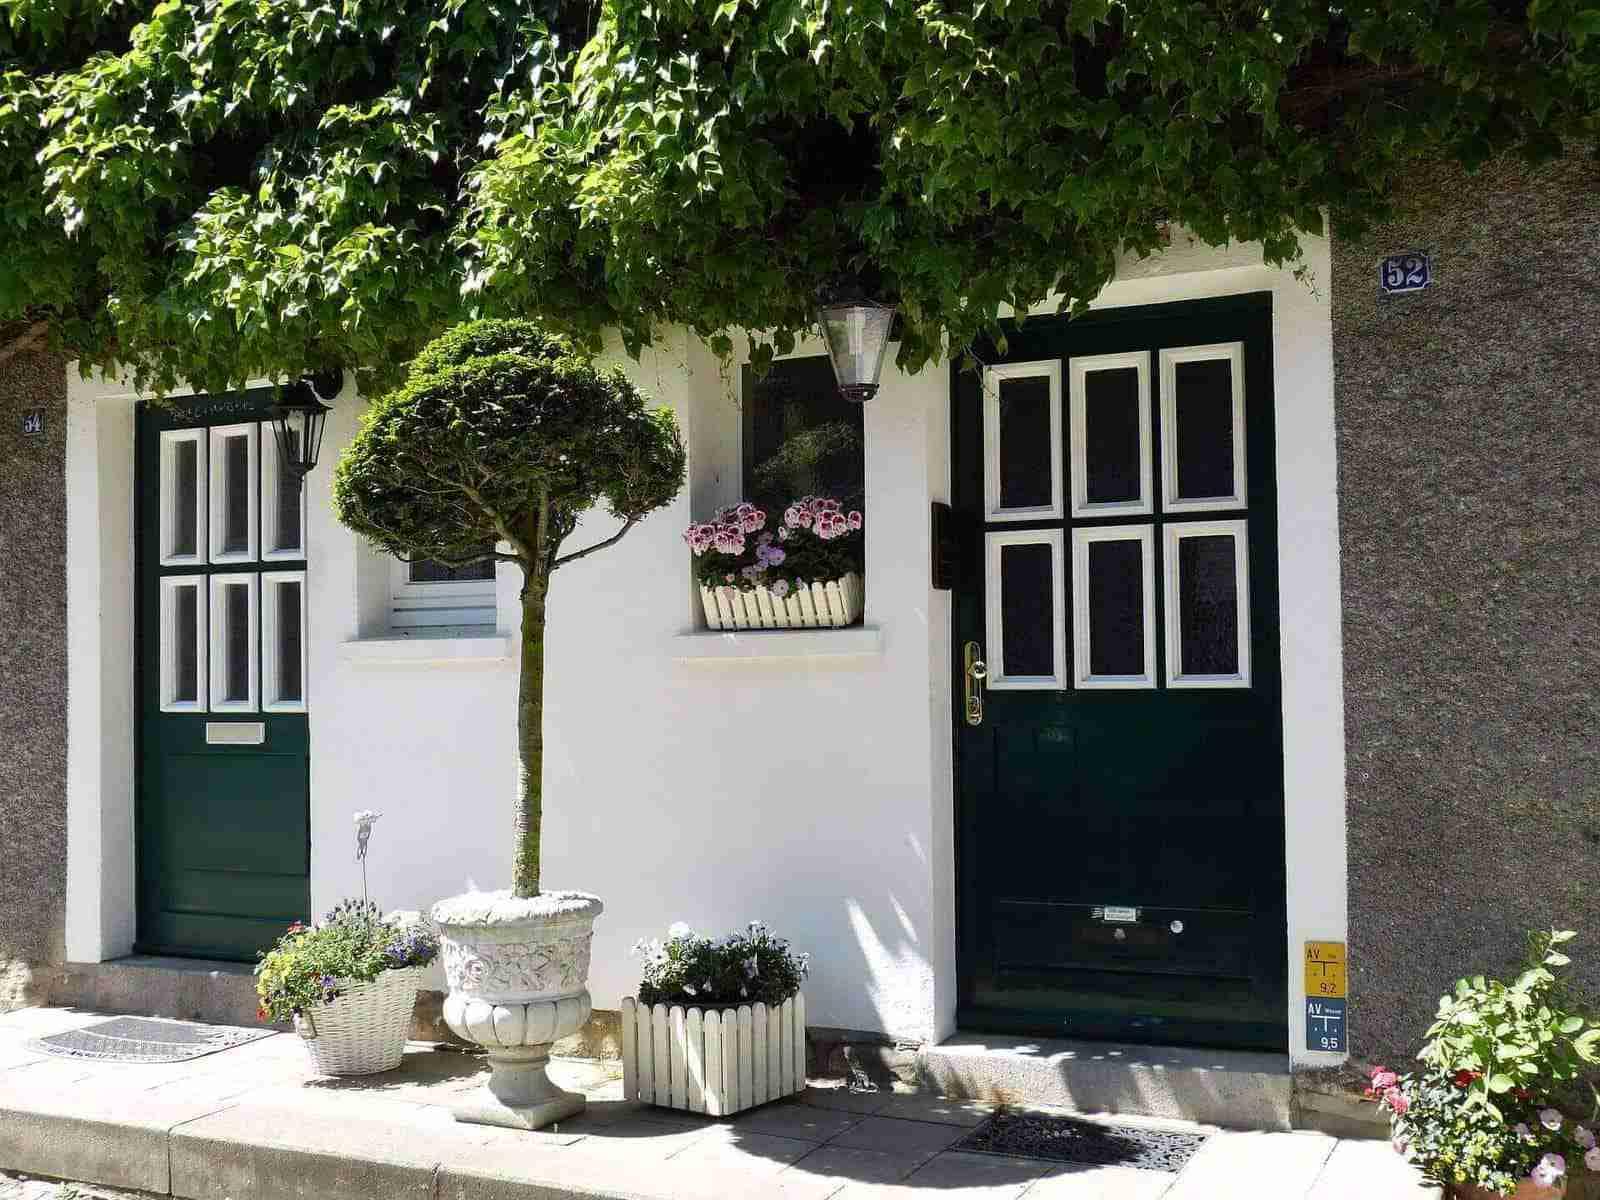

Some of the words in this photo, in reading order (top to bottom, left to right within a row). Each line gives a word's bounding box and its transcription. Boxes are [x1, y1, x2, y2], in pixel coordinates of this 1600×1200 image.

[1387, 258, 1424, 287] 52
[24, 414, 42, 432] 54
[1306, 948, 1320, 959] AV
[1308, 1003, 1321, 1014] AV
[1320, 1036, 1338, 1049] 9,5
